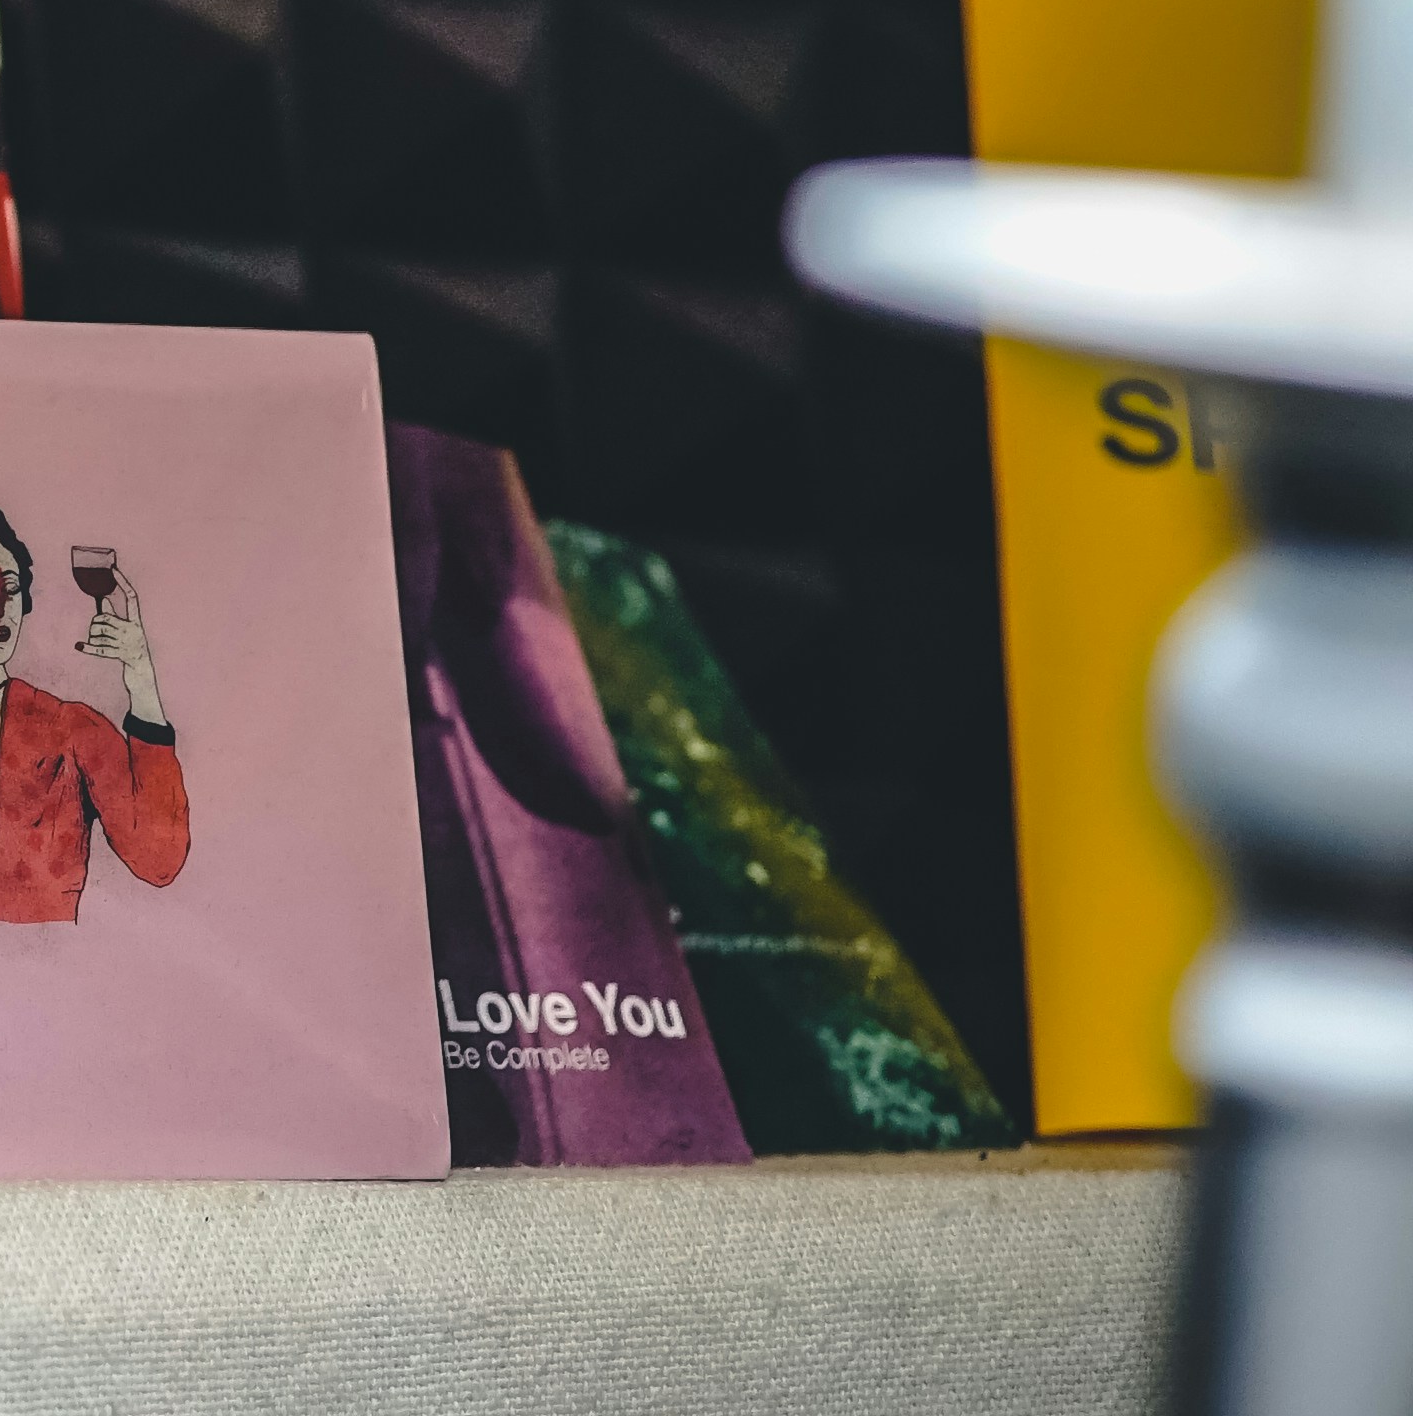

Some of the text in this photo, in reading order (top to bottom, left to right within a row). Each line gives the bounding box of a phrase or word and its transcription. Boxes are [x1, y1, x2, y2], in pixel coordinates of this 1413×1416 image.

[438, 978, 687, 1040] Love You
[443, 1039, 611, 1076] Be Complete
